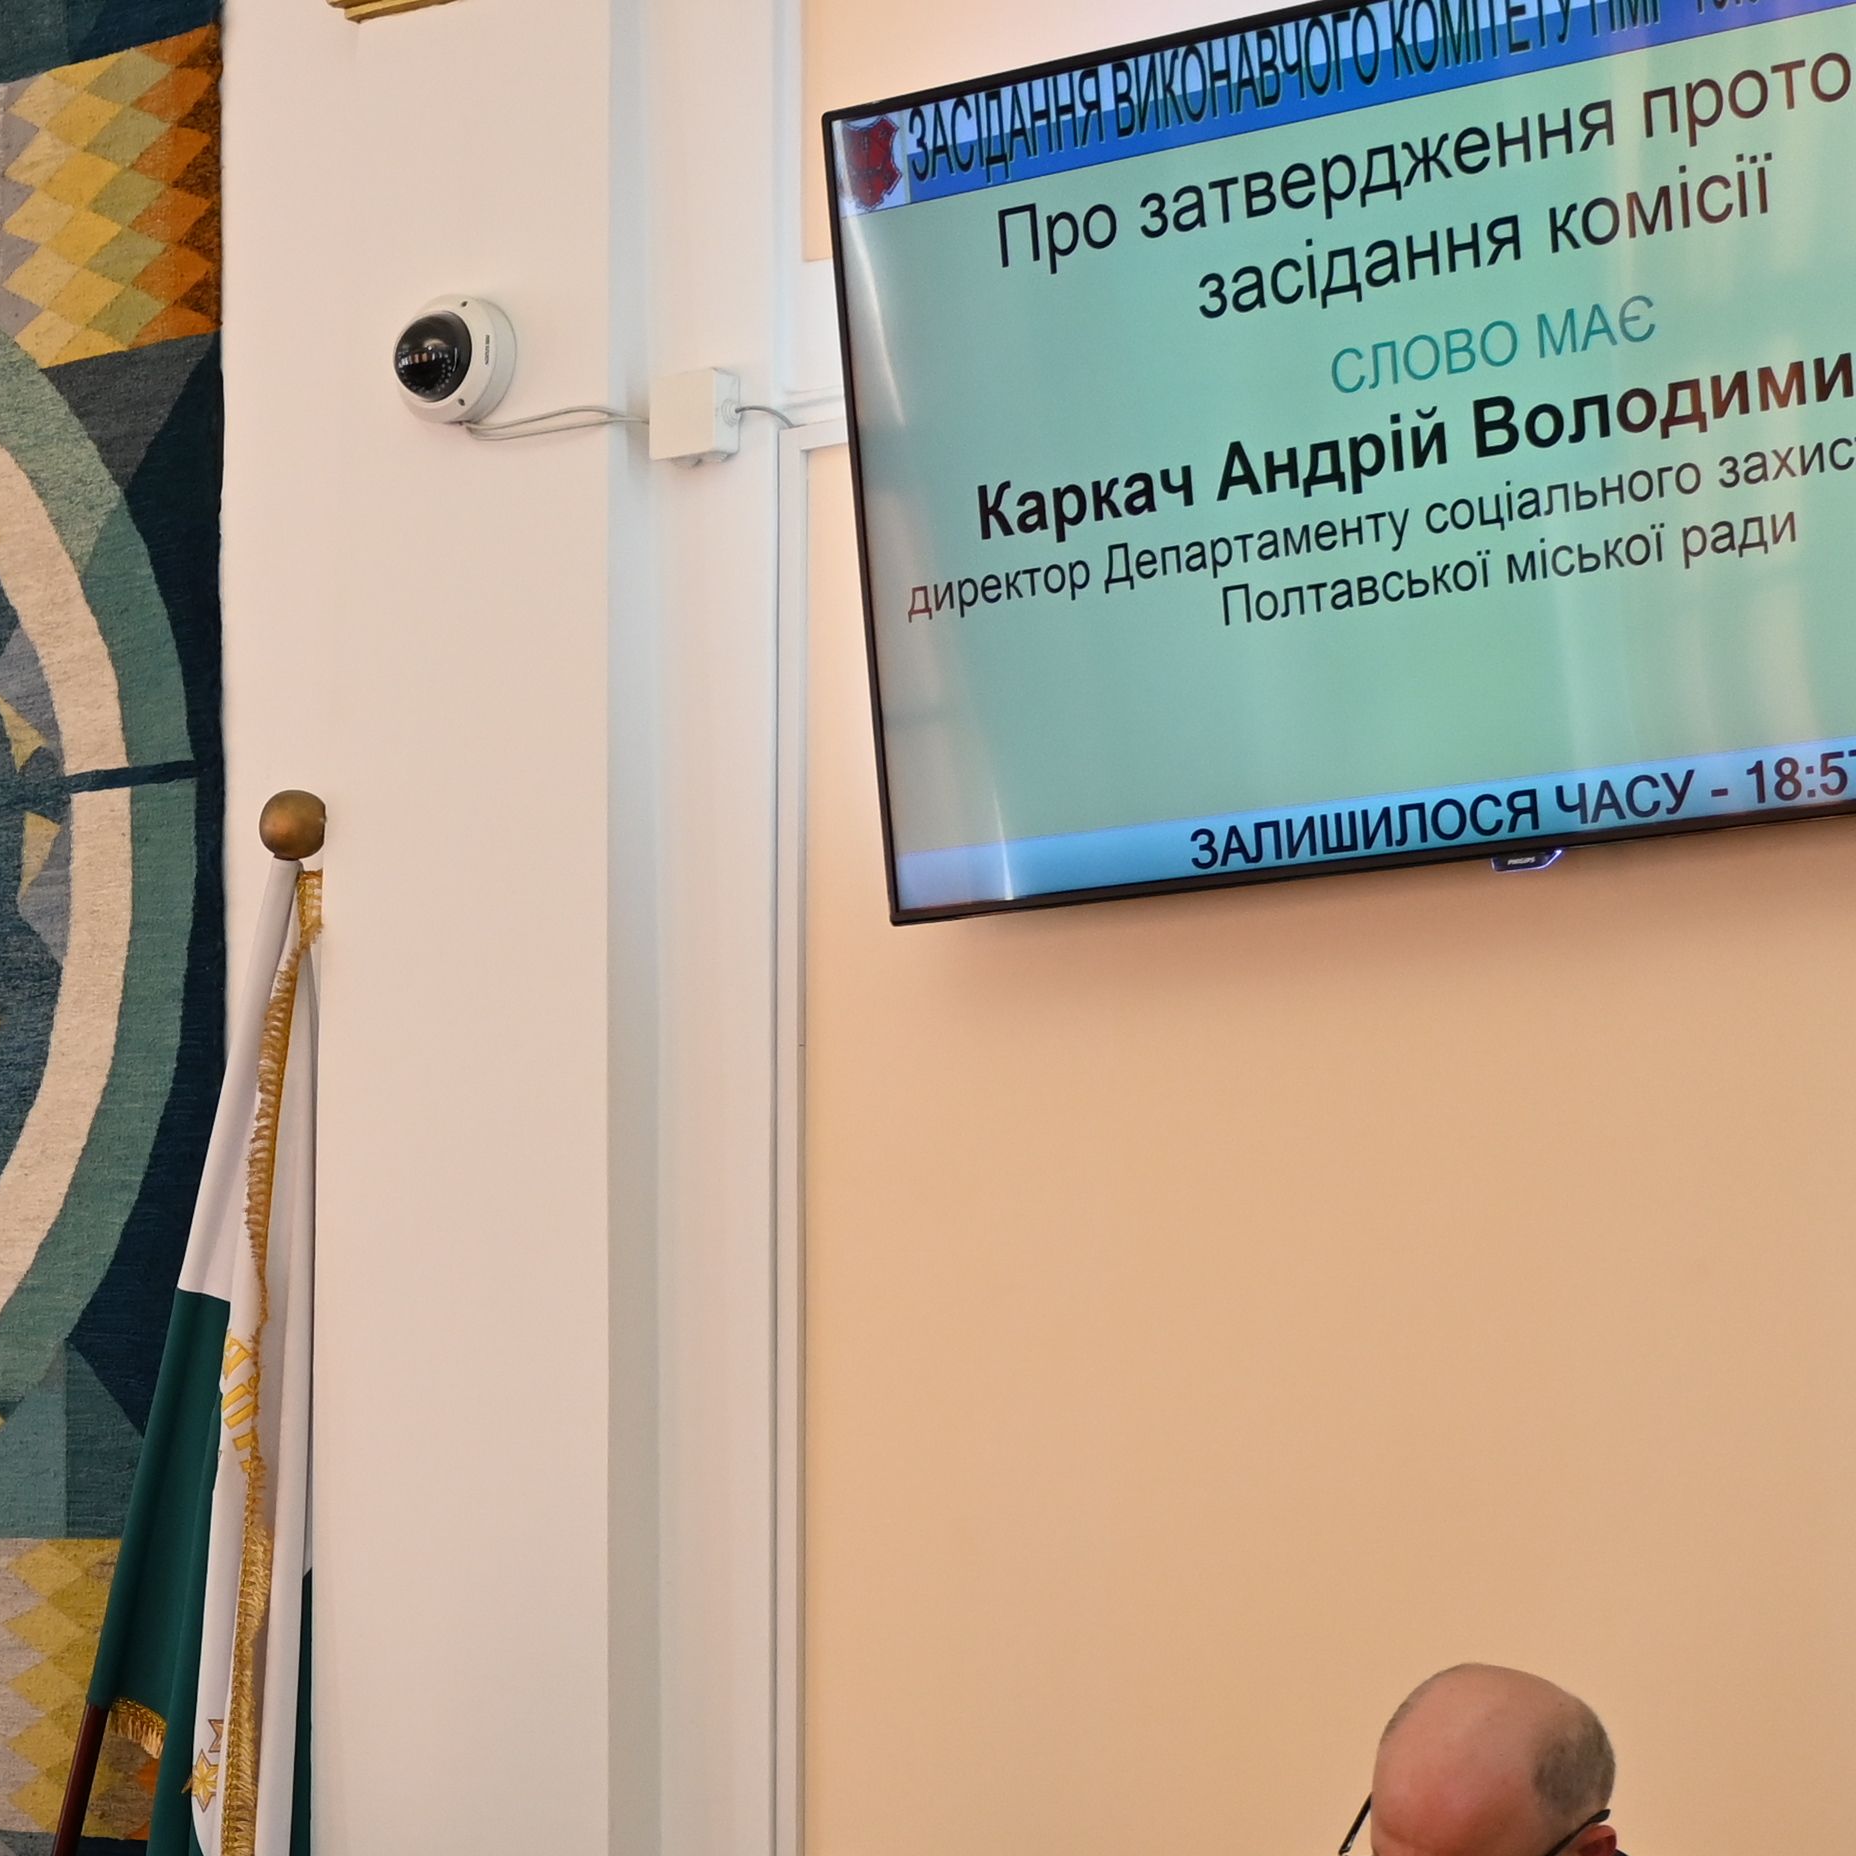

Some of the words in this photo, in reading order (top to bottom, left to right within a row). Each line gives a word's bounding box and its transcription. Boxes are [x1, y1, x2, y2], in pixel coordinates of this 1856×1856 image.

[908, 68, 1105, 183] ЗАСІДАННЯ
[1111, 6, 1380, 138] ВИКОНАВЧОГО
[998, 203, 1117, 274] Про
[1140, 100, 1614, 238] затвердження
[1643, 52, 1851, 147] прото
[1199, 215, 1521, 318] засідання
[1548, 152, 1773, 253] комісії
[1331, 320, 1518, 394] СЛОВО
[1536, 295, 1656, 358] МАЄ
[907, 559, 1090, 623] директор
[1103, 508, 1410, 594] Департаменту
[1425, 462, 1702, 534] соціального
[1718, 437, 1856, 489] захис
[977, 465, 1193, 543] Каркач
[1217, 405, 1448, 501] Андрій
[1473, 352, 1854, 458] Володими
[1221, 549, 1491, 626] Полтавської
[1507, 522, 1666, 585] міської
[1682, 511, 1797, 570] ради
[1189, 788, 1538, 870] ЗАЛИШИЛОСЯ
[1554, 769, 1695, 827] ЧАСУ
